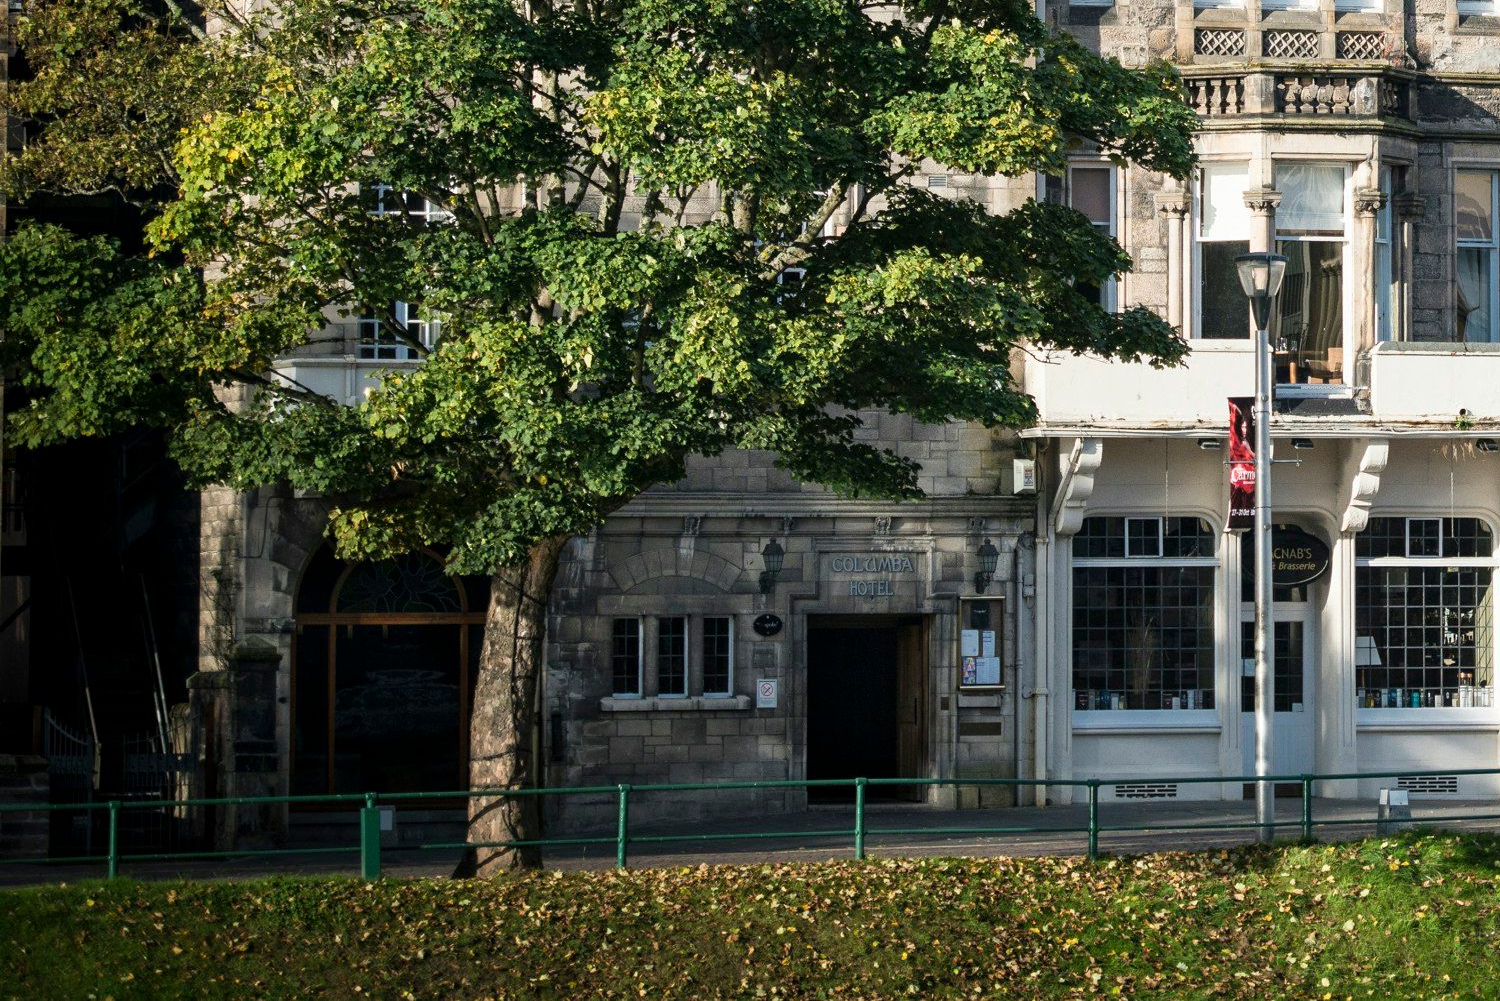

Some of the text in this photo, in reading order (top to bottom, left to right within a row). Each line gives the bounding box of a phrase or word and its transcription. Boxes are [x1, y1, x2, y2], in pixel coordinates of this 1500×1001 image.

[1231, 467, 1256, 482] Carm
[1272, 548, 1313, 559] CNAB'S
[832, 557, 914, 573] COLUMBA
[1278, 561, 1316, 570] Brasserie
[849, 580, 894, 596] HOTEL
